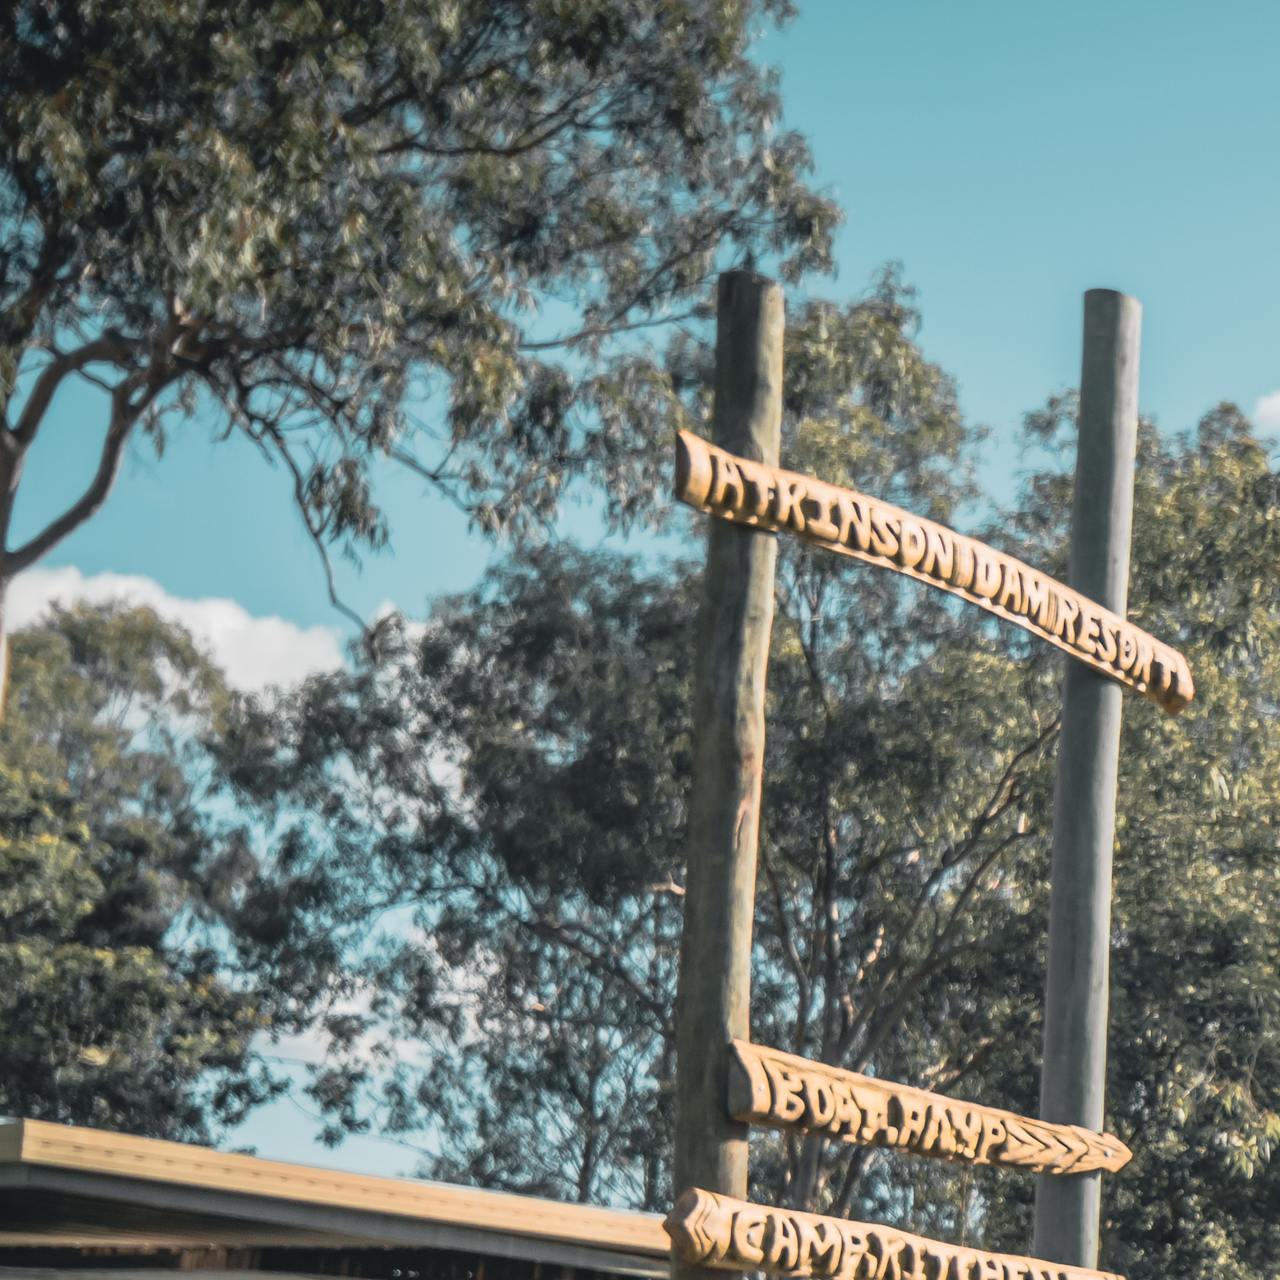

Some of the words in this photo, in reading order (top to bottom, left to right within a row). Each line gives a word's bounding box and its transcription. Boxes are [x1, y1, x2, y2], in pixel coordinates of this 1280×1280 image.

[711, 455, 954, 580] ATKINSON
[973, 552, 1050, 631] DAM
[1054, 593, 1179, 691] RESORT
